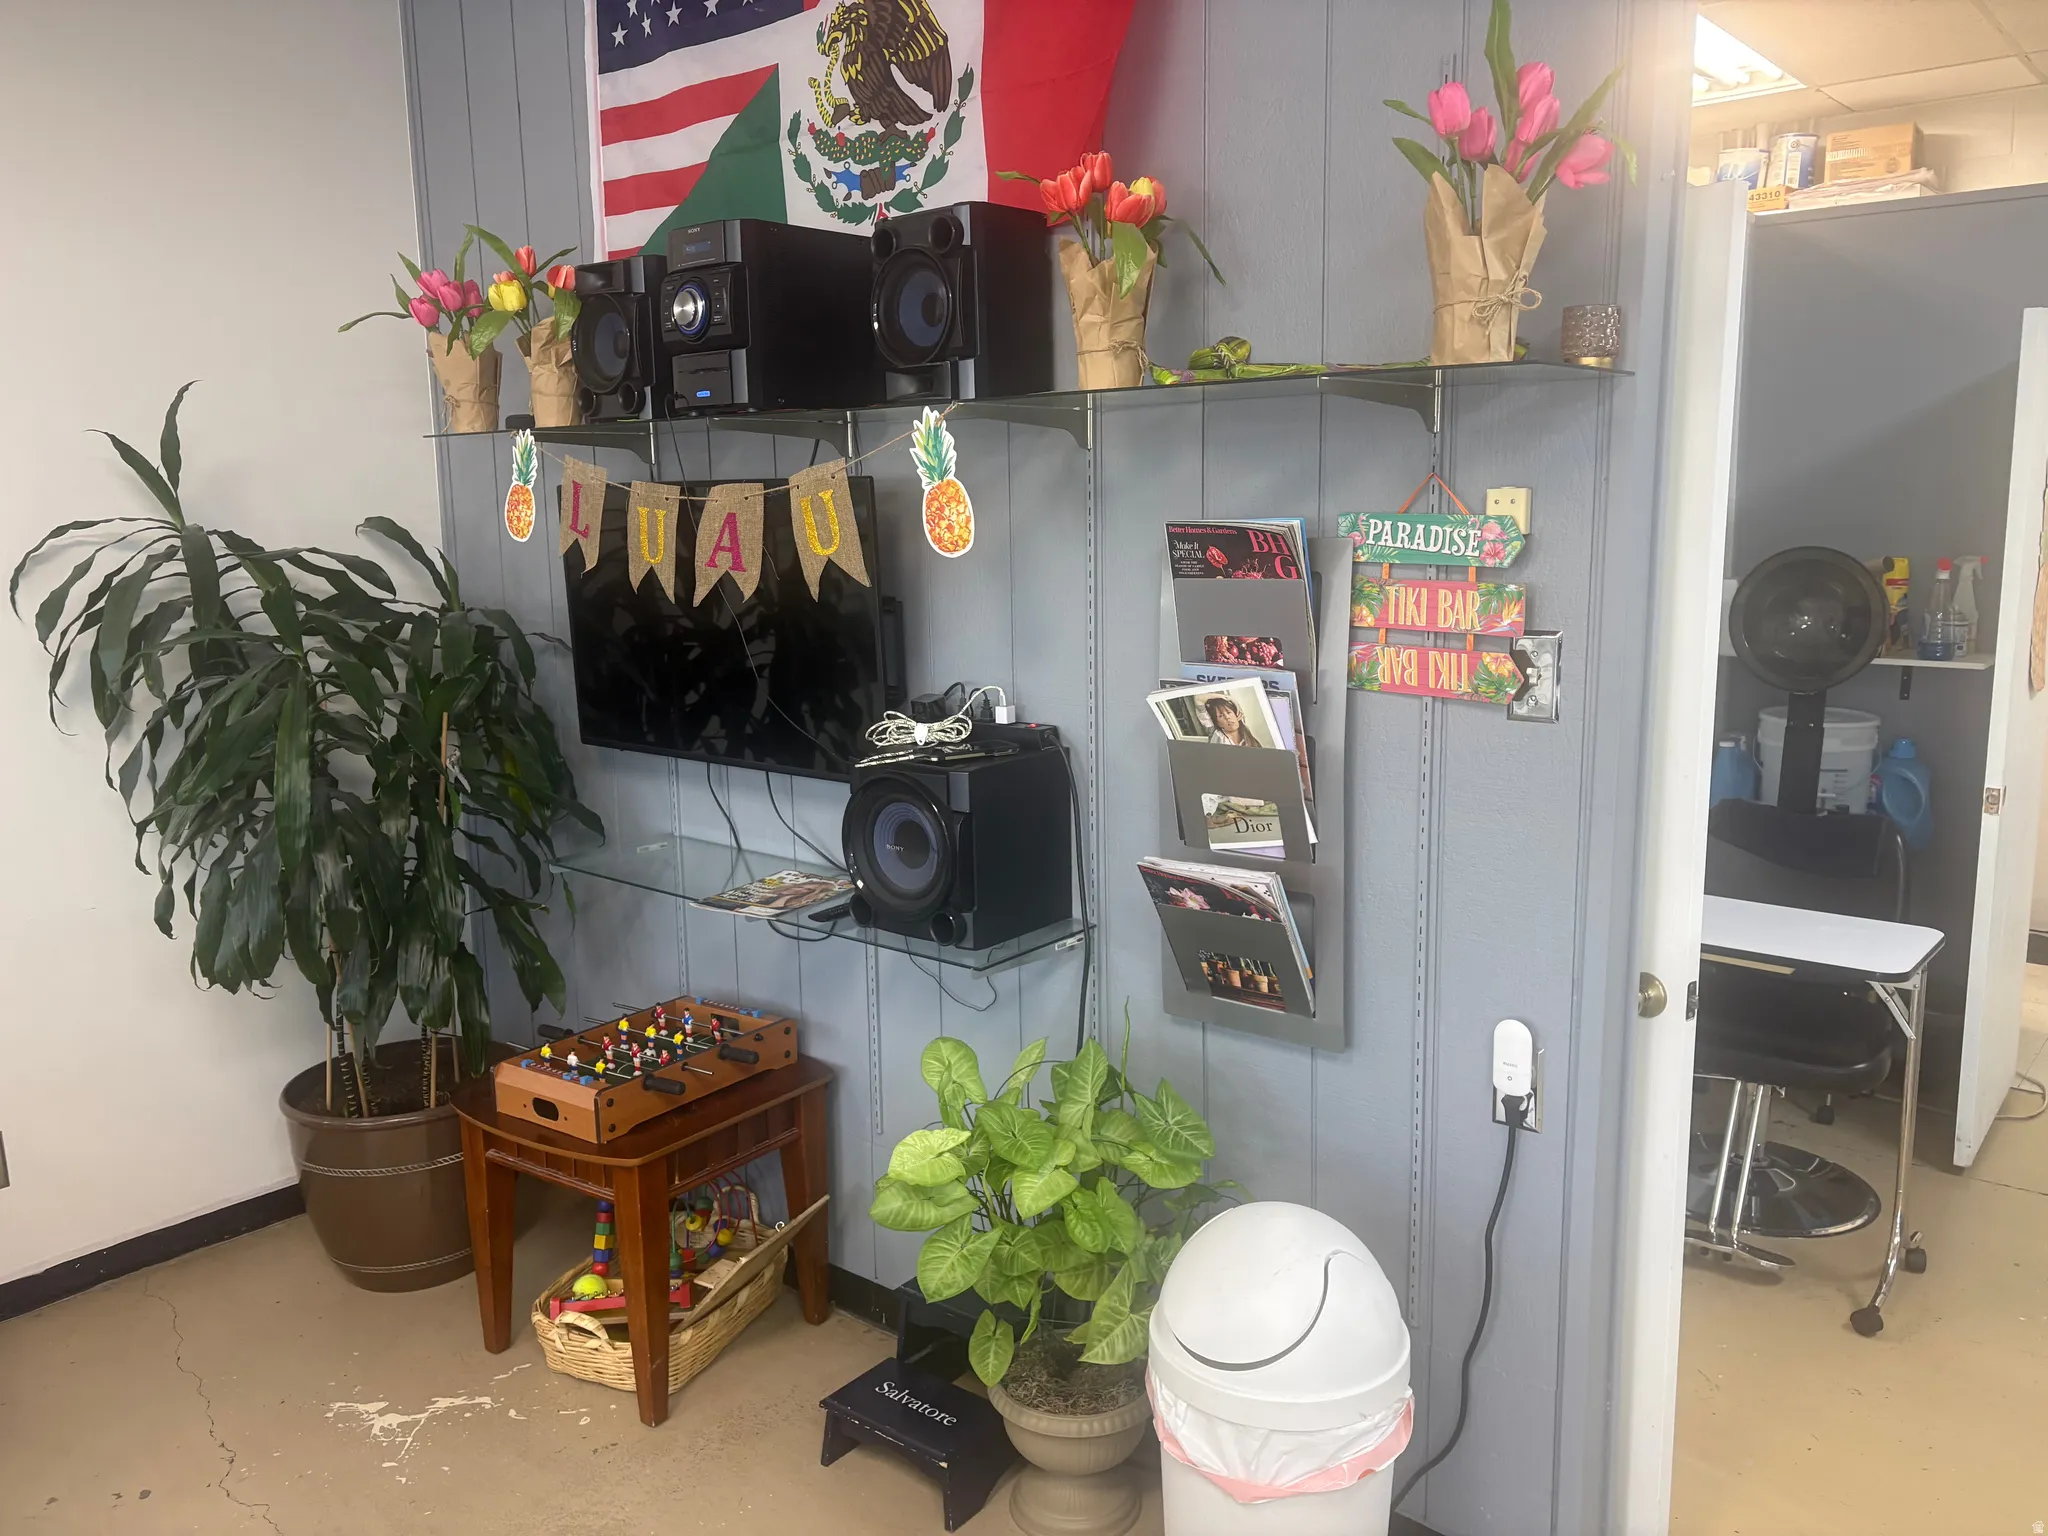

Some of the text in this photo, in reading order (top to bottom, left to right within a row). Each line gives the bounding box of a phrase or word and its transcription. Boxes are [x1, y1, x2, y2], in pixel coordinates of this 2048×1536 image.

[1749, 190, 1781, 201] 43310
[1168, 525, 1185, 533] Better
[1365, 518, 1483, 557] PARADISE
[1173, 539, 1194, 550] Make
[1386, 585, 1482, 632] TIKI BAR
[1375, 646, 1472, 692] TIKI BAR
[1233, 816, 1273, 834] Dior
[886, 843, 905, 852] SONY
[875, 1381, 957, 1427] Salvatore
